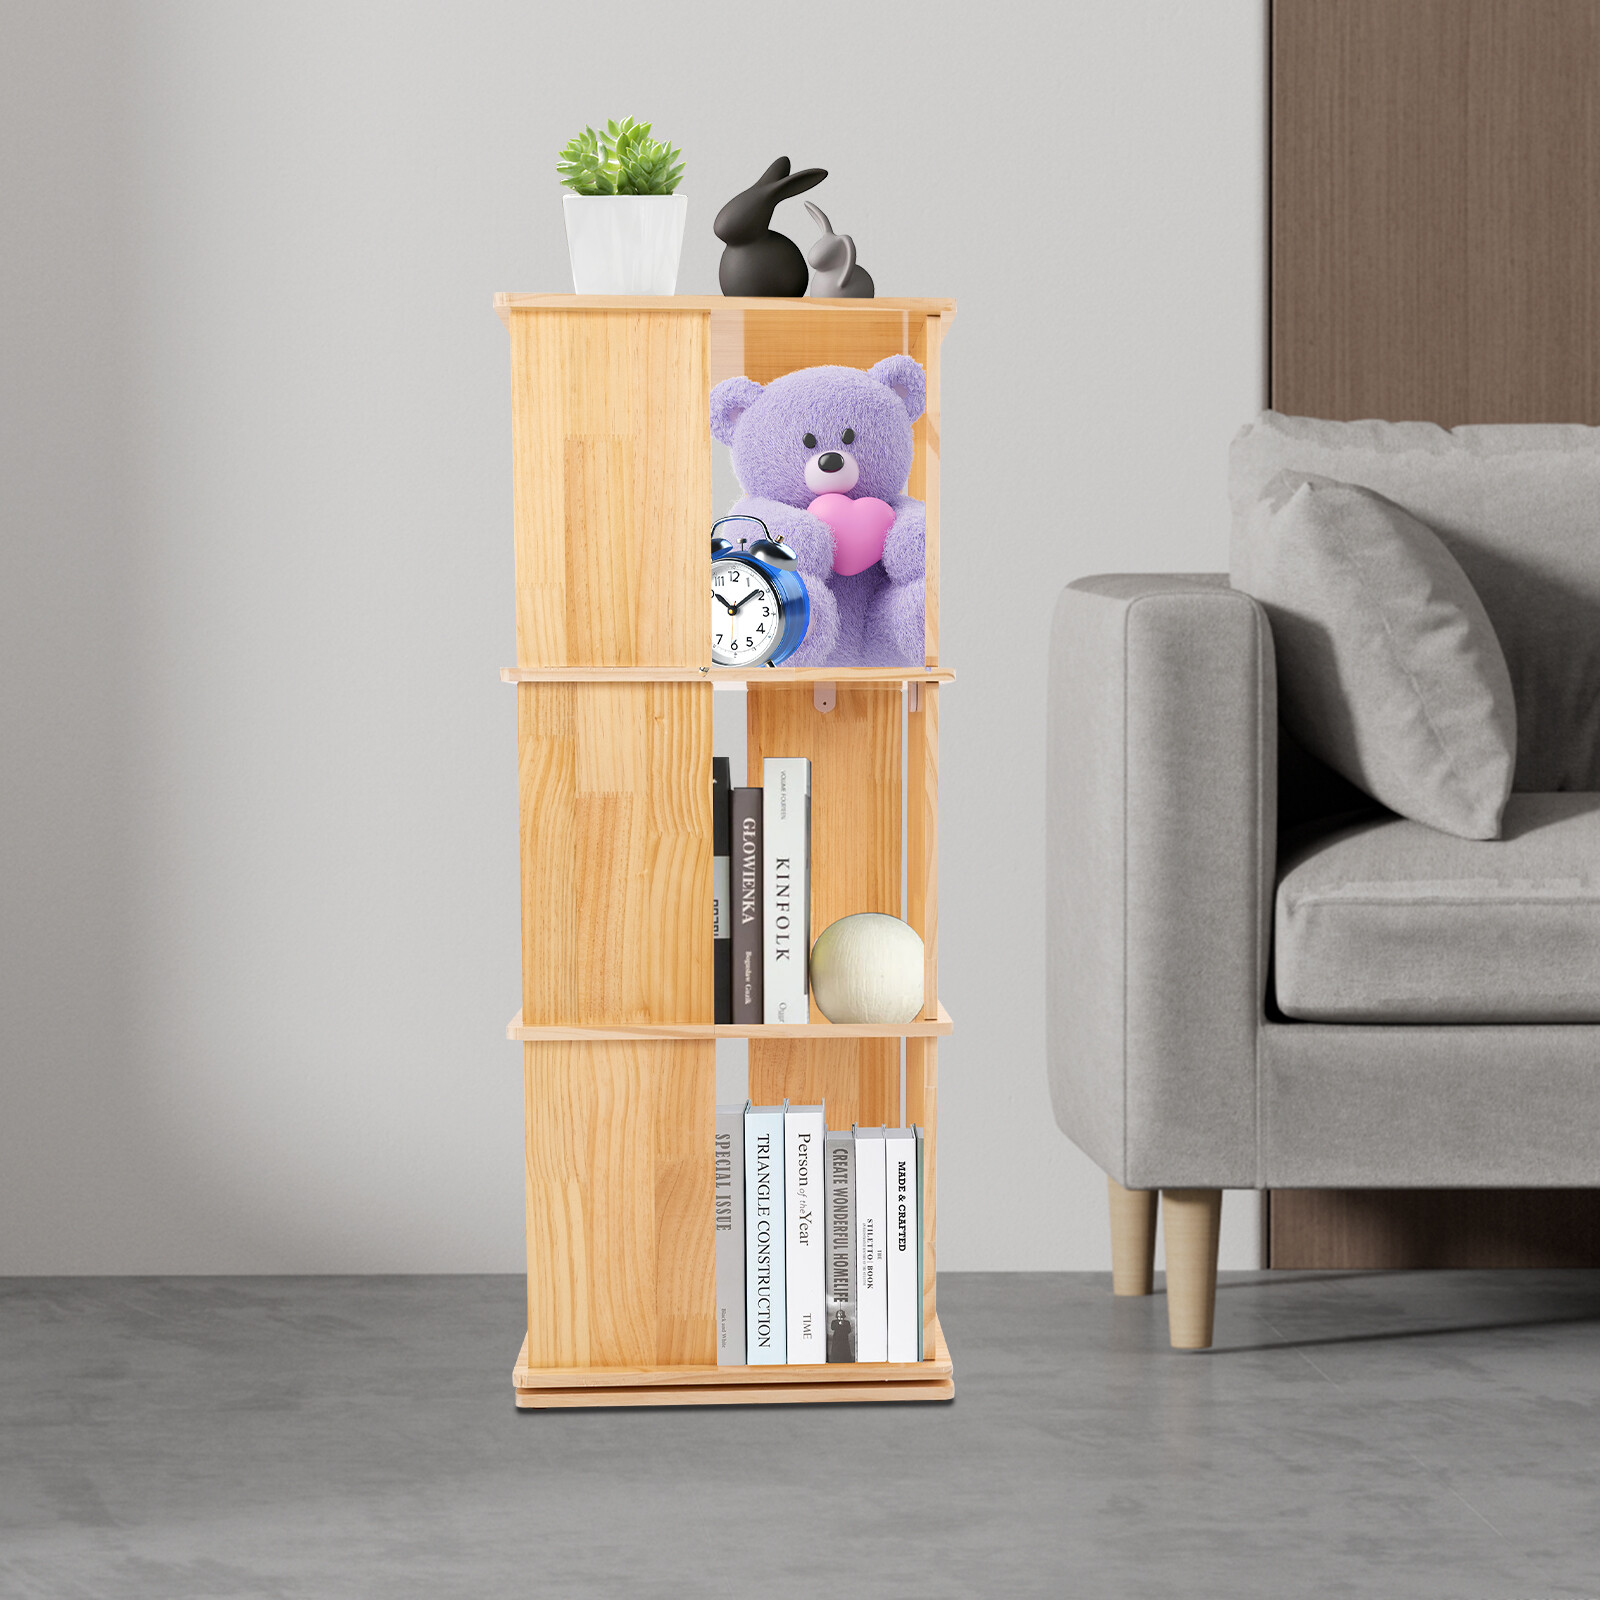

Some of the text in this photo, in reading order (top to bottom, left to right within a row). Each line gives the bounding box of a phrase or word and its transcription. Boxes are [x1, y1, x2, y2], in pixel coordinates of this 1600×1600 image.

[727, 571, 740, 583] 12
[745, 576, 751, 588] 1
[758, 590, 765, 601] 2
[762, 606, 769, 617] 3
[756, 622, 766, 634] 4
[715, 633, 724, 645] 7
[730, 639, 739, 651] 6
[746, 636, 754, 648] 5
[775, 858, 790, 961] KINFOLK
[798, 1133, 811, 1186] Person
[715, 1133, 731, 1231] SPECIAL ISSUE
[898, 1160, 906, 1252] MADE & CRAFTED
[832, 1148, 849, 1303] CREATE WONDERFUL HOMELIFE
[757, 1133, 770, 1348] TRIANGLE CONSTRUCTION
[866, 1218, 874, 1289] STILETTO BOOK
[802, 1312, 812, 1340] TIME
